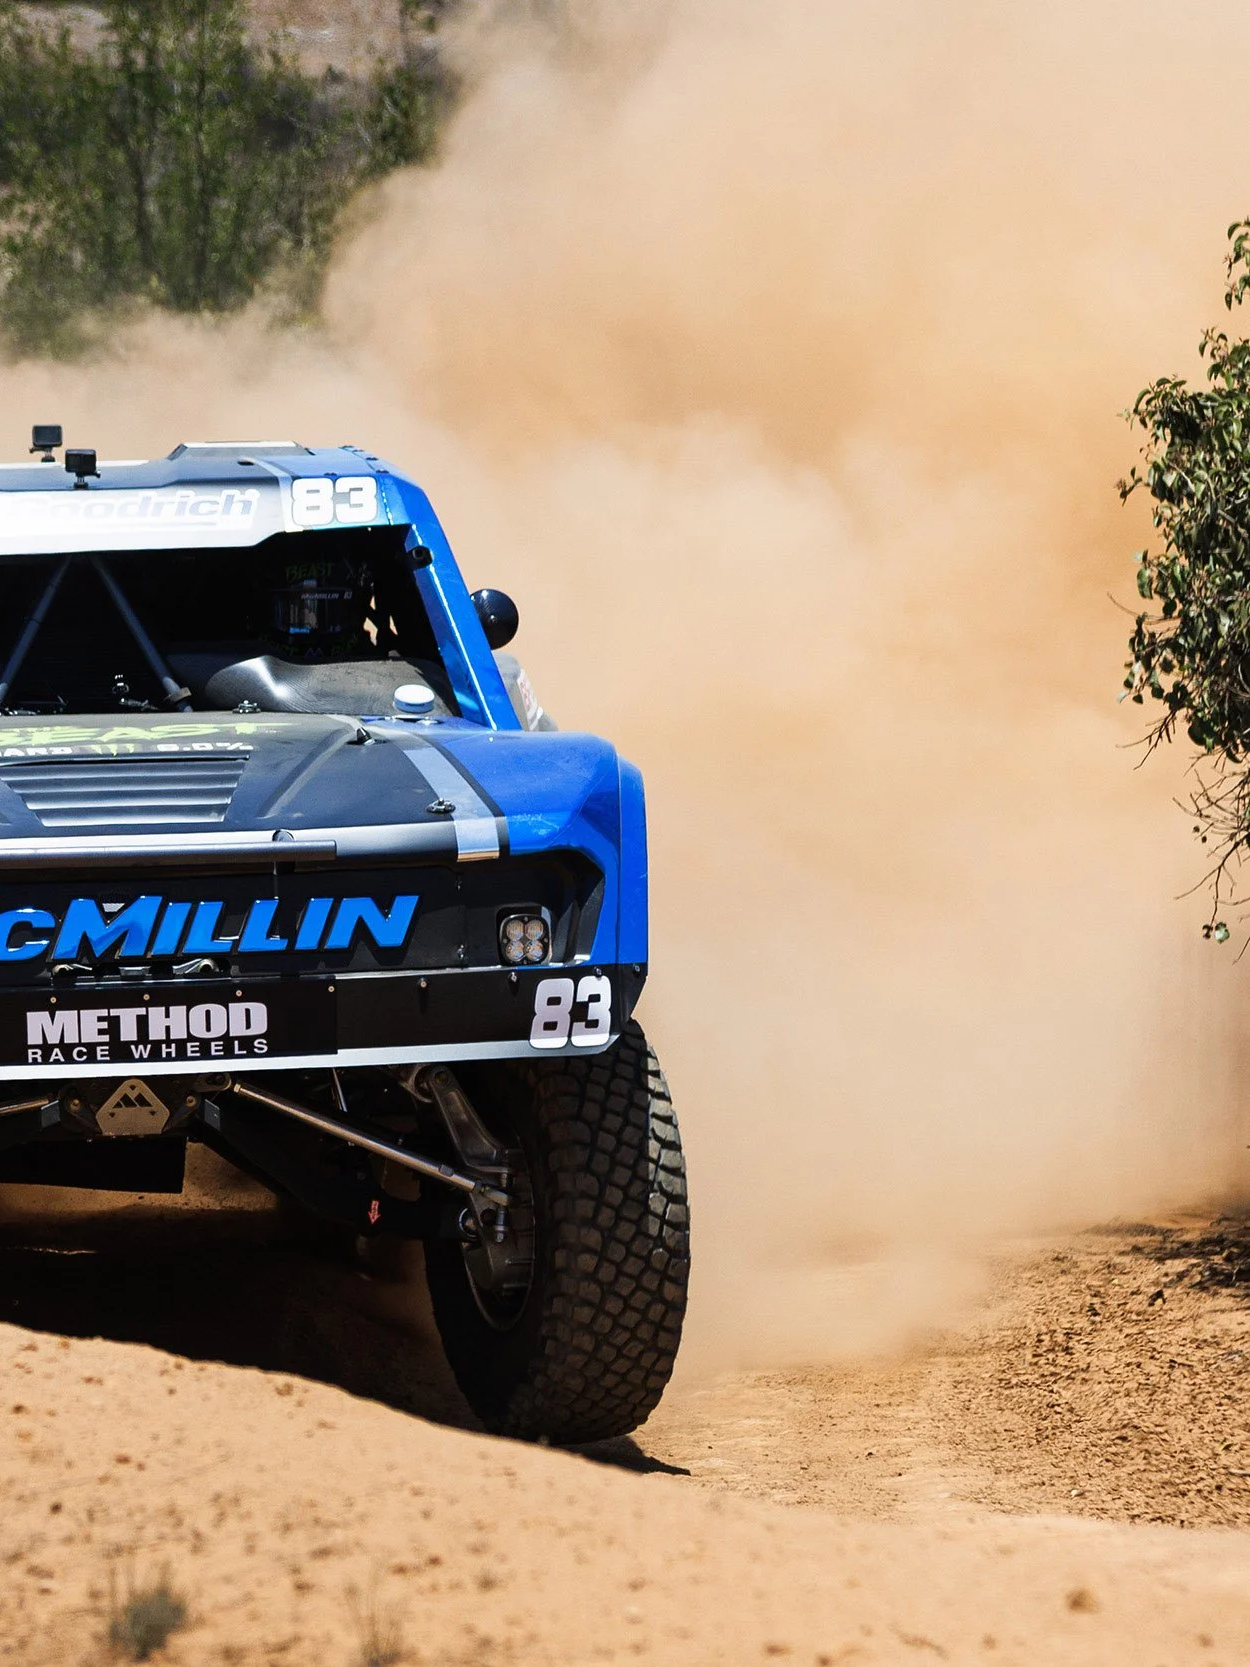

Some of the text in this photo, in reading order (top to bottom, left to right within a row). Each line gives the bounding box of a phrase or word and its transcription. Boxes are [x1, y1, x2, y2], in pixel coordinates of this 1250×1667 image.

[291, 476, 378, 526] 83
[26, 1003, 269, 1045] METHOD
[529, 976, 611, 1049] 83
[27, 1038, 269, 1064] RACE WHEELS
